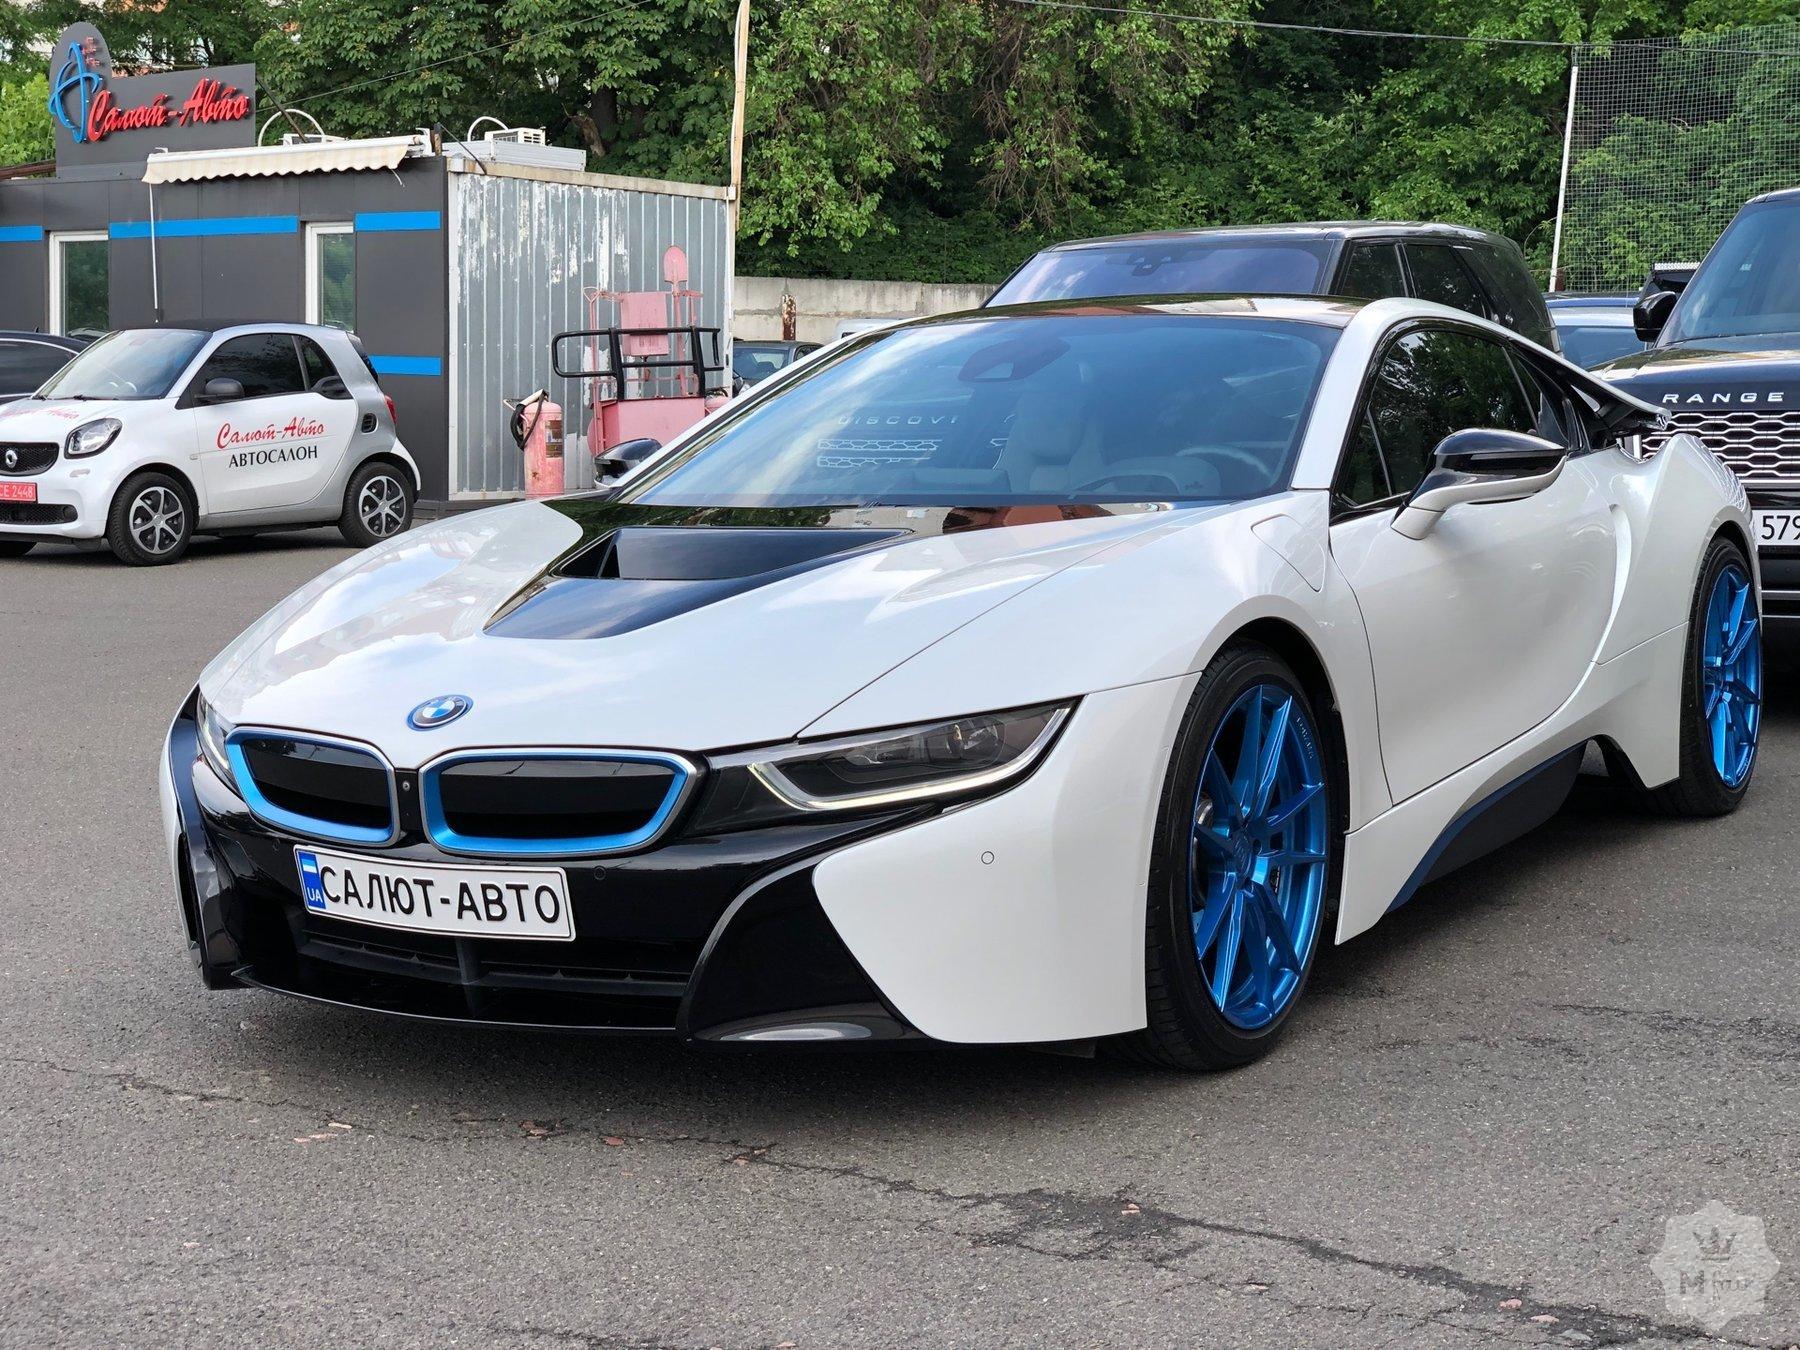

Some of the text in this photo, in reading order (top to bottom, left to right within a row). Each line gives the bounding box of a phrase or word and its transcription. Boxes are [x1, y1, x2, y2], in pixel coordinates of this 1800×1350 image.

[88, 78, 250, 142] Салют-Авто
[1662, 392, 1785, 404] RANGE
[217, 416, 325, 449] Салют-Авто
[229, 445, 318, 468] АВТОСАЛОН
[12, 485, 33, 499] 2448
[308, 886, 323, 903] UA
[320, 865, 561, 924] САЛЮТ-АВТО
